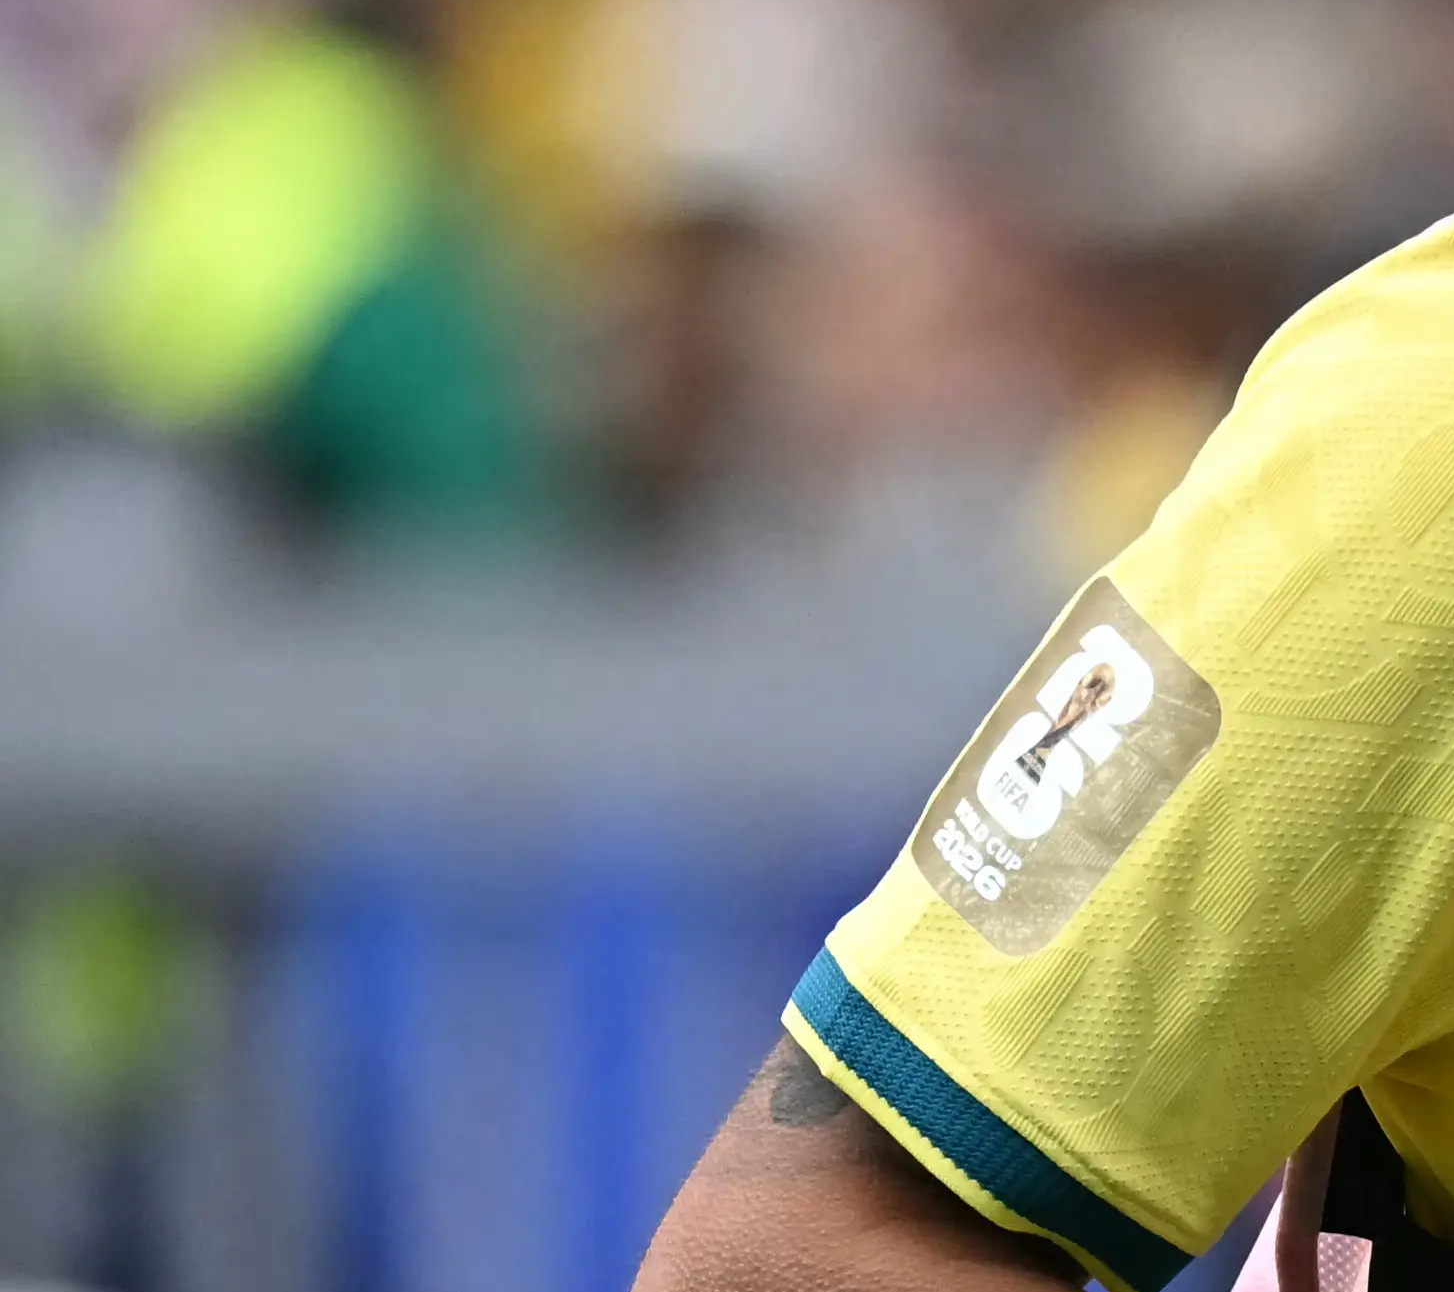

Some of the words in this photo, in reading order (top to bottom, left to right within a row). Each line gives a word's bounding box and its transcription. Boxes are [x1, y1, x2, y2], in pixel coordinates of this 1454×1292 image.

[996, 772, 1029, 813] FIFA
[933, 818, 1006, 901] 2026
[987, 837, 1022, 870] CUP
